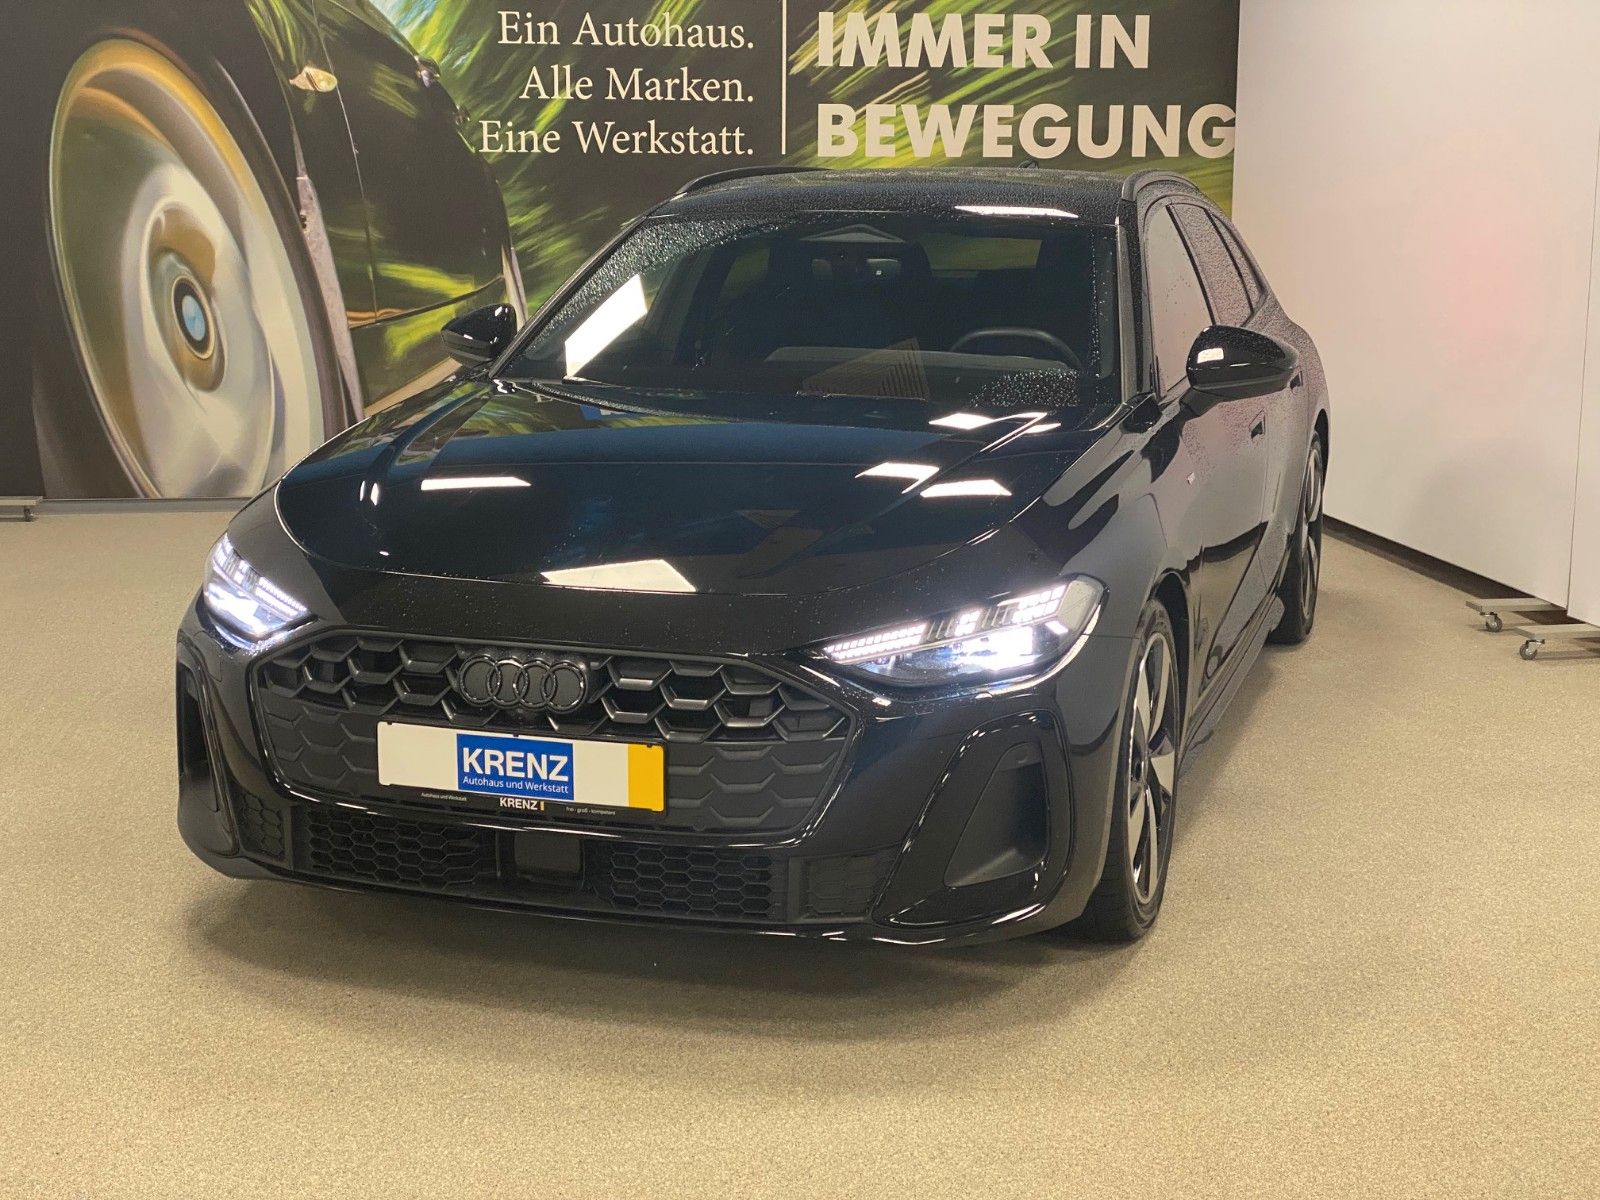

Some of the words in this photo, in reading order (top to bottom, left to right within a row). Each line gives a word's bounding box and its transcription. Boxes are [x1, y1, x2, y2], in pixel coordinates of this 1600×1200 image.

[497, 10, 560, 45] Ein
[572, 11, 754, 49] Autohaus.
[817, 11, 1053, 69] IMMER
[1075, 14, 1150, 69] IN
[518, 64, 593, 100] Alle
[604, 67, 754, 102] Marken.
[478, 119, 561, 153] Eine
[571, 120, 754, 155] Werkstatt.
[816, 103, 1236, 159] BEWEGUNG
[462, 747, 569, 782] KRENZ
[462, 776, 504, 788] Autohaus
[505, 781, 523, 790] und
[525, 782, 569, 794] Werkstatt
[499, 797, 538, 810] KRENZ
